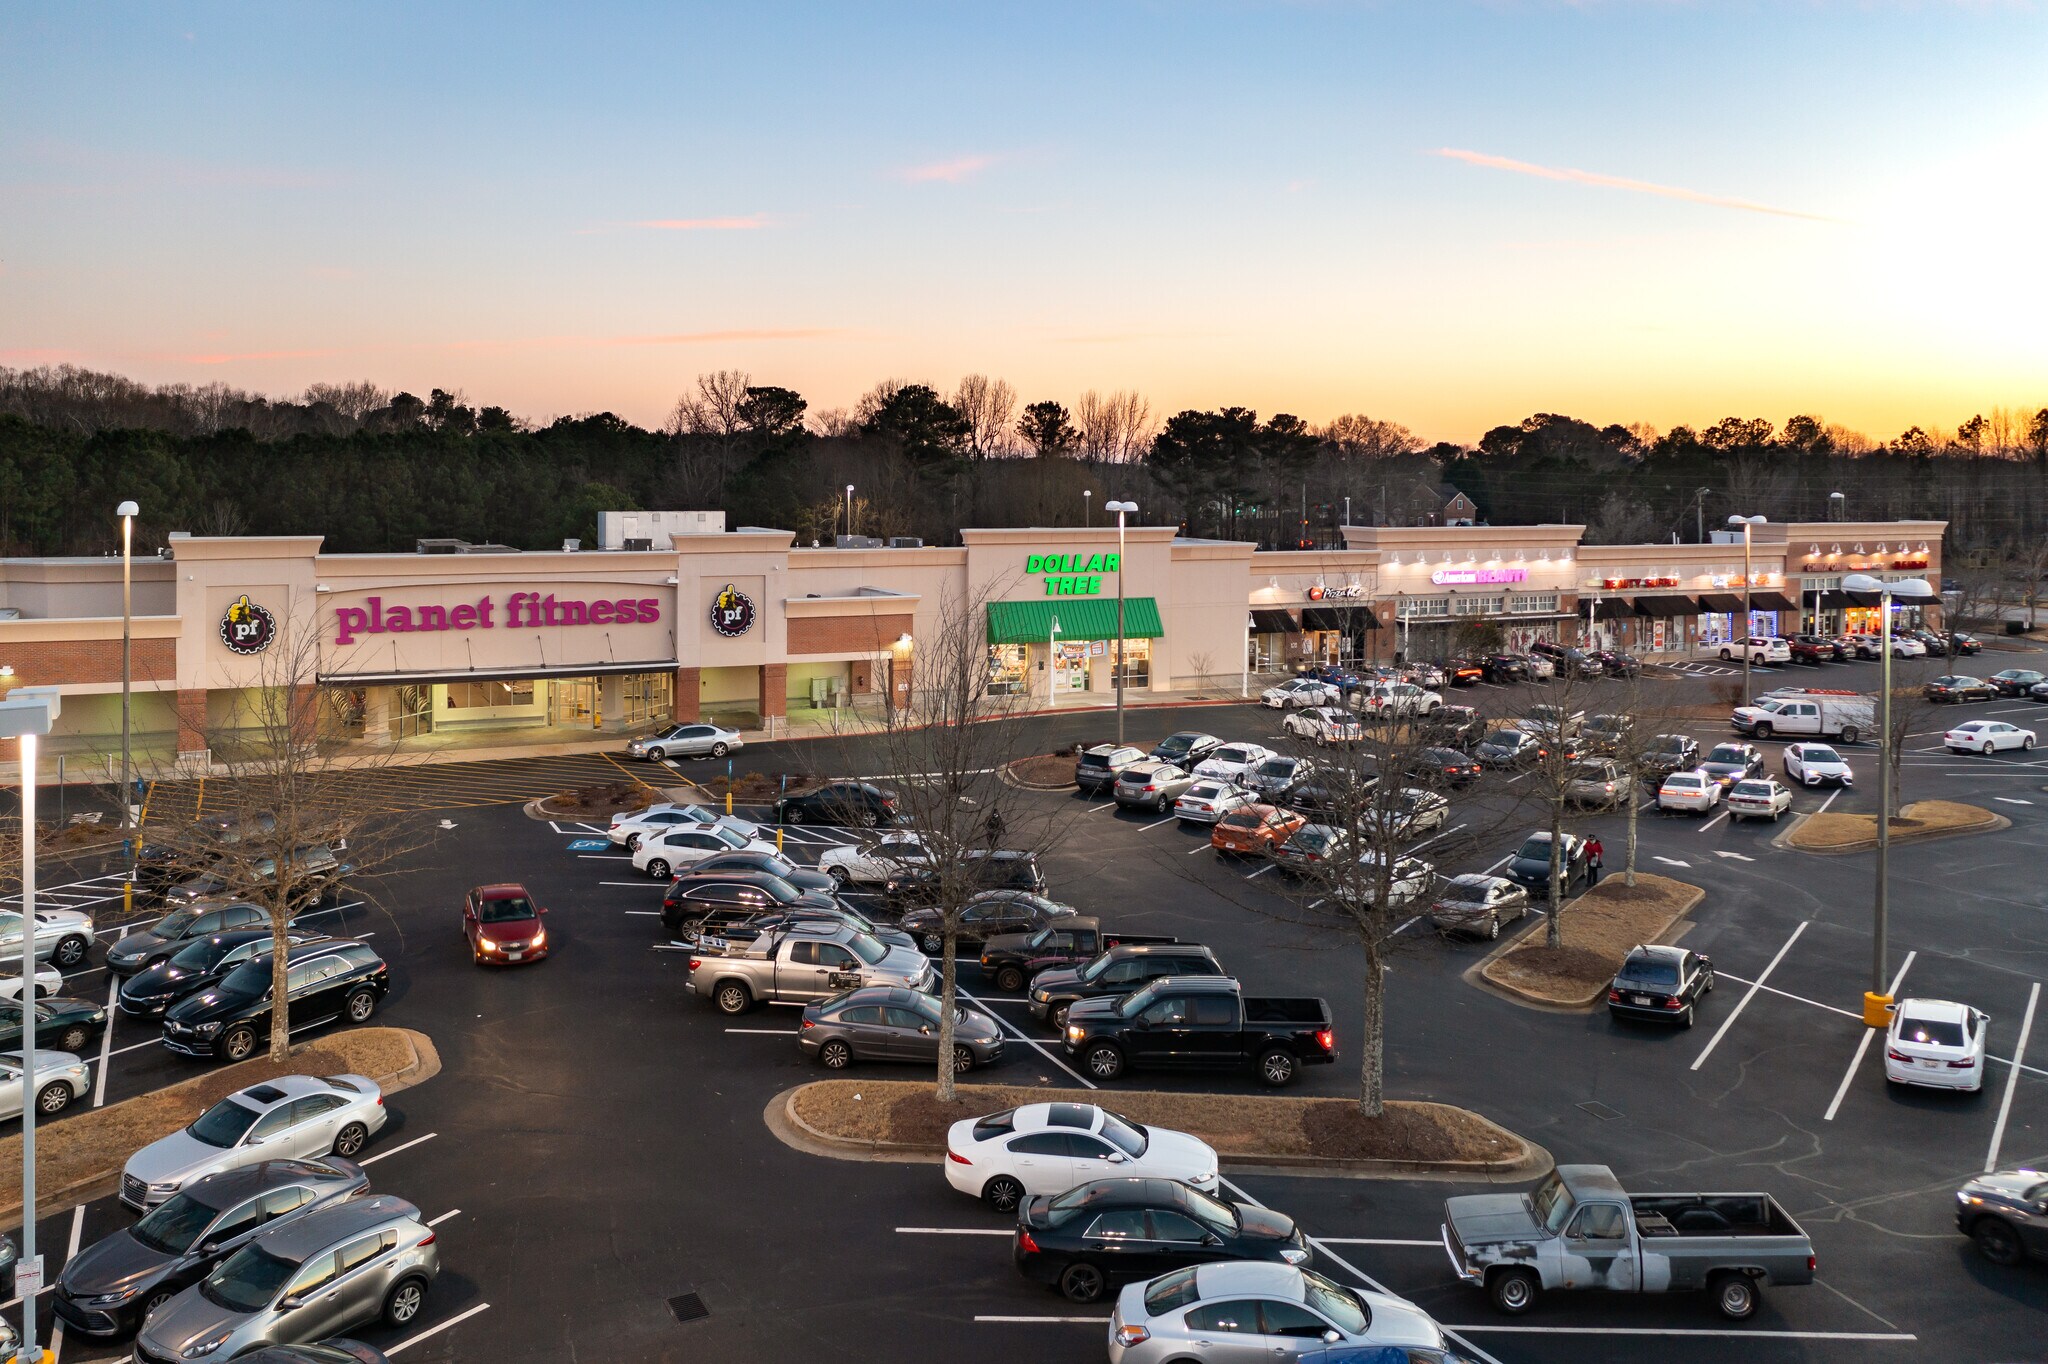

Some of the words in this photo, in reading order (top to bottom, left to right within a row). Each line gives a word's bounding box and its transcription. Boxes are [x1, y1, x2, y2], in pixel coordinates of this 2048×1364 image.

[1026, 553, 1120, 573] DOLLAR
[1044, 575, 1103, 595] TREE
[1477, 569, 1528, 583] BEAUTY
[1322, 588, 1346, 599] Pizza
[335, 595, 495, 645] planet
[507, 592, 660, 628] fitness
[724, 606, 743, 624] pf
[235, 619, 260, 640] pf
